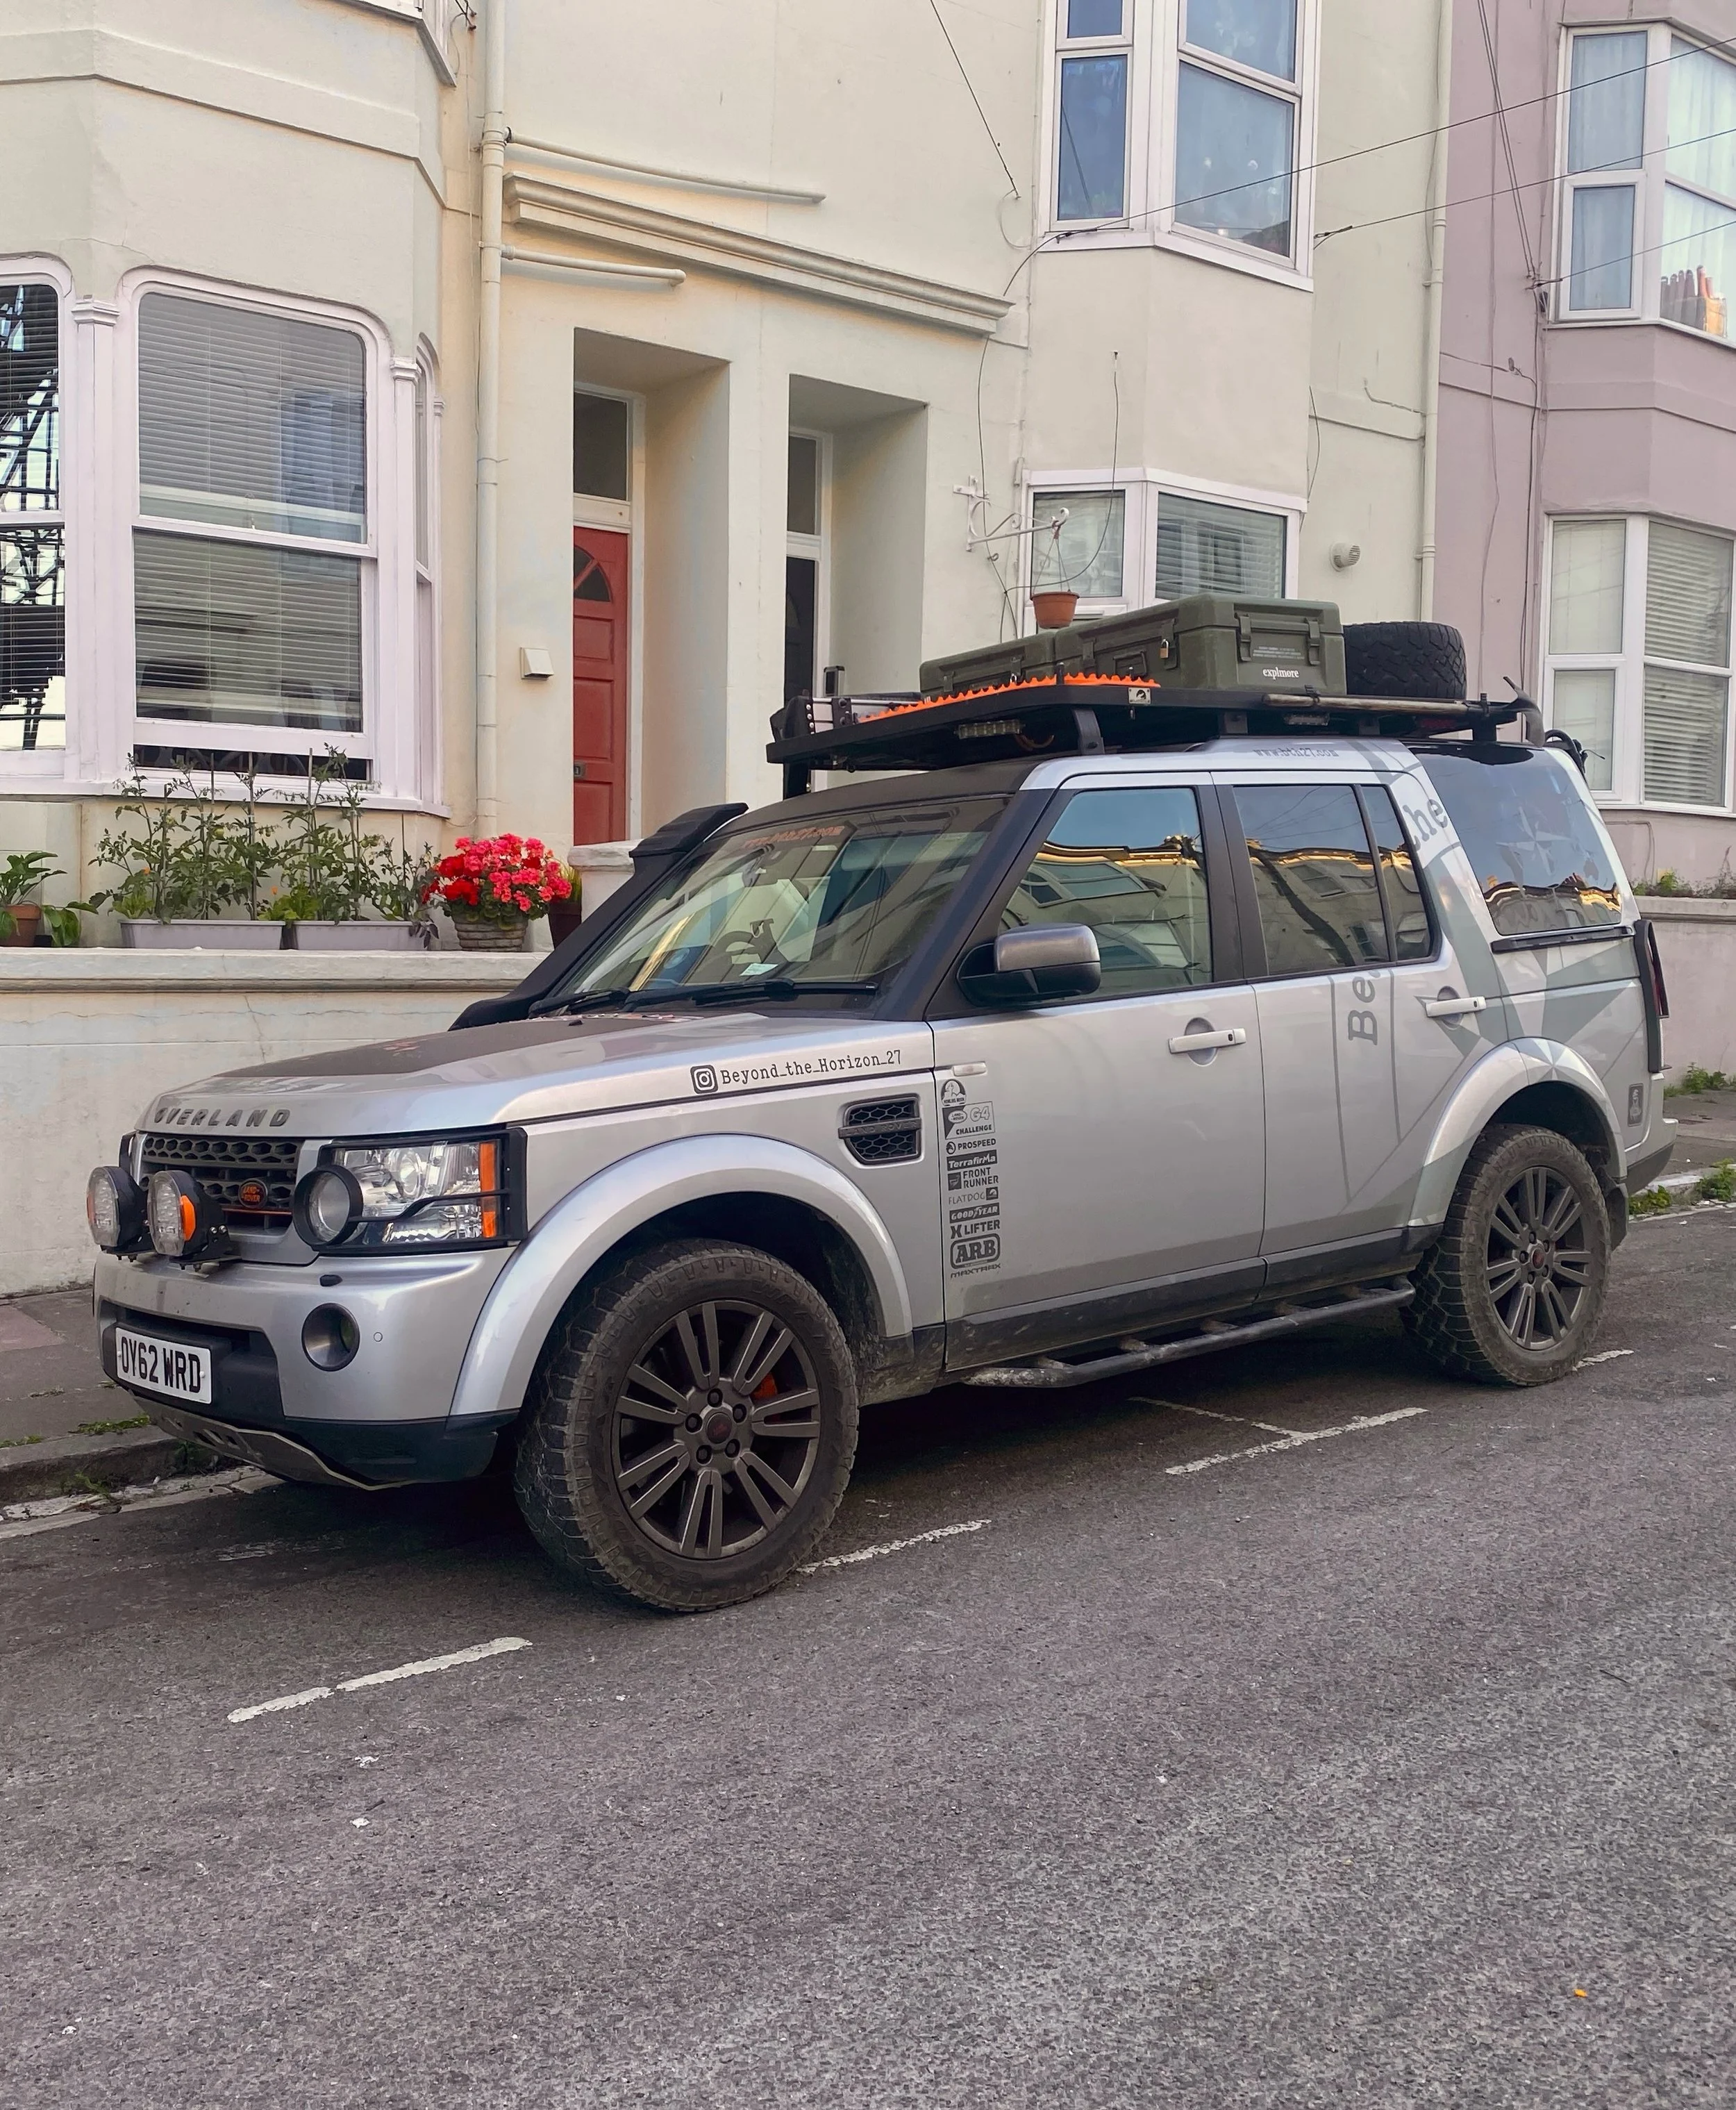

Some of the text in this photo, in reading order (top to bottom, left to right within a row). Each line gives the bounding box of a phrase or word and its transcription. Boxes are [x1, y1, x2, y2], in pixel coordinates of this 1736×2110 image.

[720, 1049, 902, 1085] Beyond_the_Horizon_27
[153, 1107, 290, 1127] OVERLAND
[970, 1105, 990, 1122] G4
[955, 1124, 992, 1135] CHALLENGE
[958, 1138, 996, 1150] PROSPEED
[963, 1167, 991, 1179] FRONT
[963, 1175, 999, 1188] RUNNER
[949, 1192, 985, 1204] FLATDOG
[951, 1206, 998, 1220] GOODYEAR
[955, 1239, 996, 1264] ARB
[122, 1336, 201, 1393] OY62 WRD
